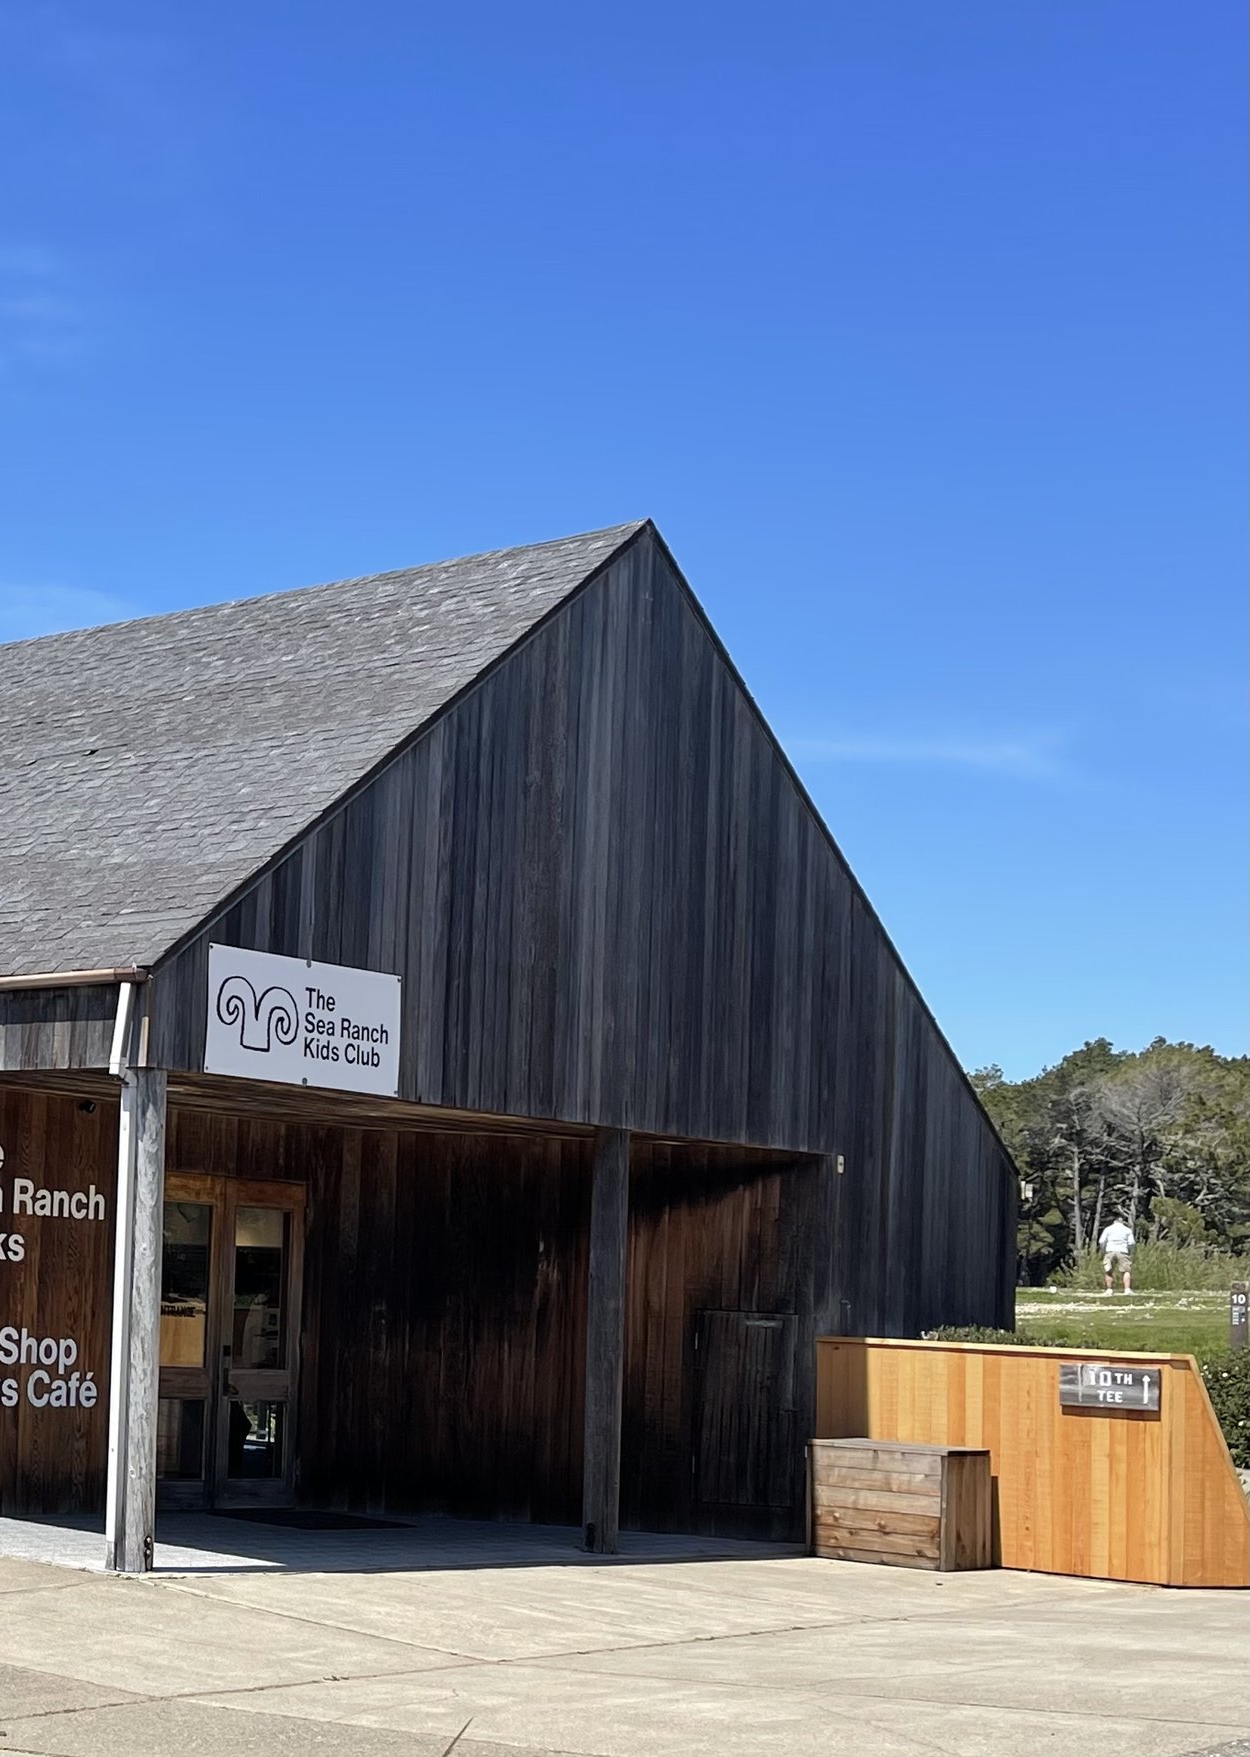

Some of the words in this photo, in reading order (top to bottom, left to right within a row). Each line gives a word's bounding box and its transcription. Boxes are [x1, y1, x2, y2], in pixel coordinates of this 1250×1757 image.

[305, 987, 336, 1012] The
[304, 1011, 335, 1036] Sea
[340, 1017, 389, 1045] Ranch
[303, 1037, 340, 1062] Kids
[344, 1043, 380, 1068] Club
[13, 1177, 106, 1221] Ranch
[1231, 1293, 1247, 1304] 10
[27, 1369, 98, 1408] Café
[1097, 1389, 1123, 1403] TEE
